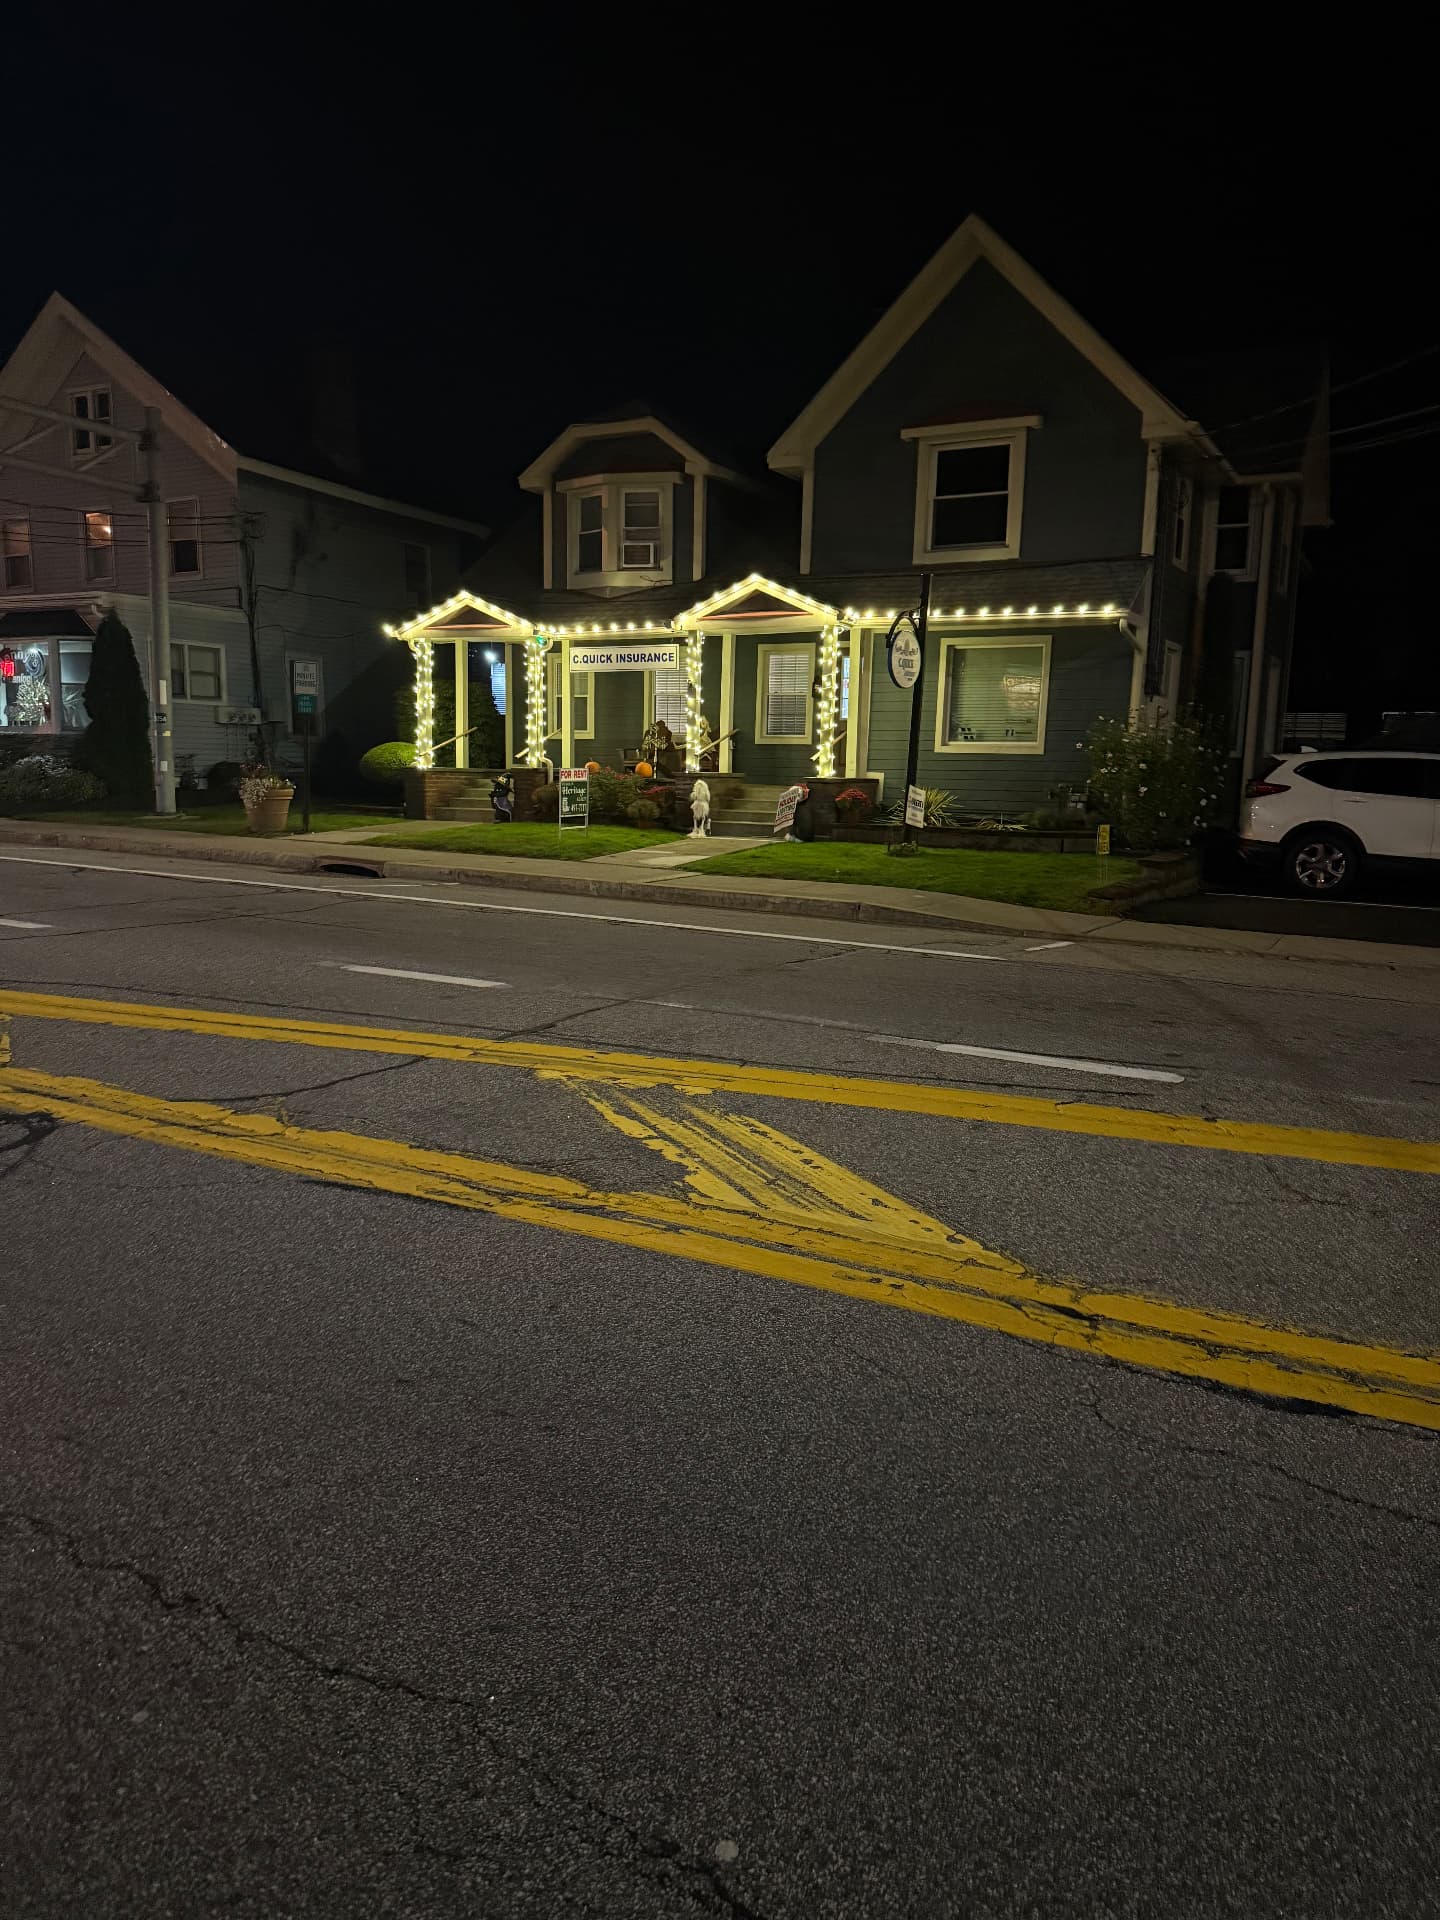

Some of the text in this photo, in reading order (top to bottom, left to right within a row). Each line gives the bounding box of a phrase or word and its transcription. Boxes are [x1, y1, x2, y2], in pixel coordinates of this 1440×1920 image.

[573, 652, 675, 664] C.QUICK INSURANCE
[561, 769, 588, 779] FOR RENT
